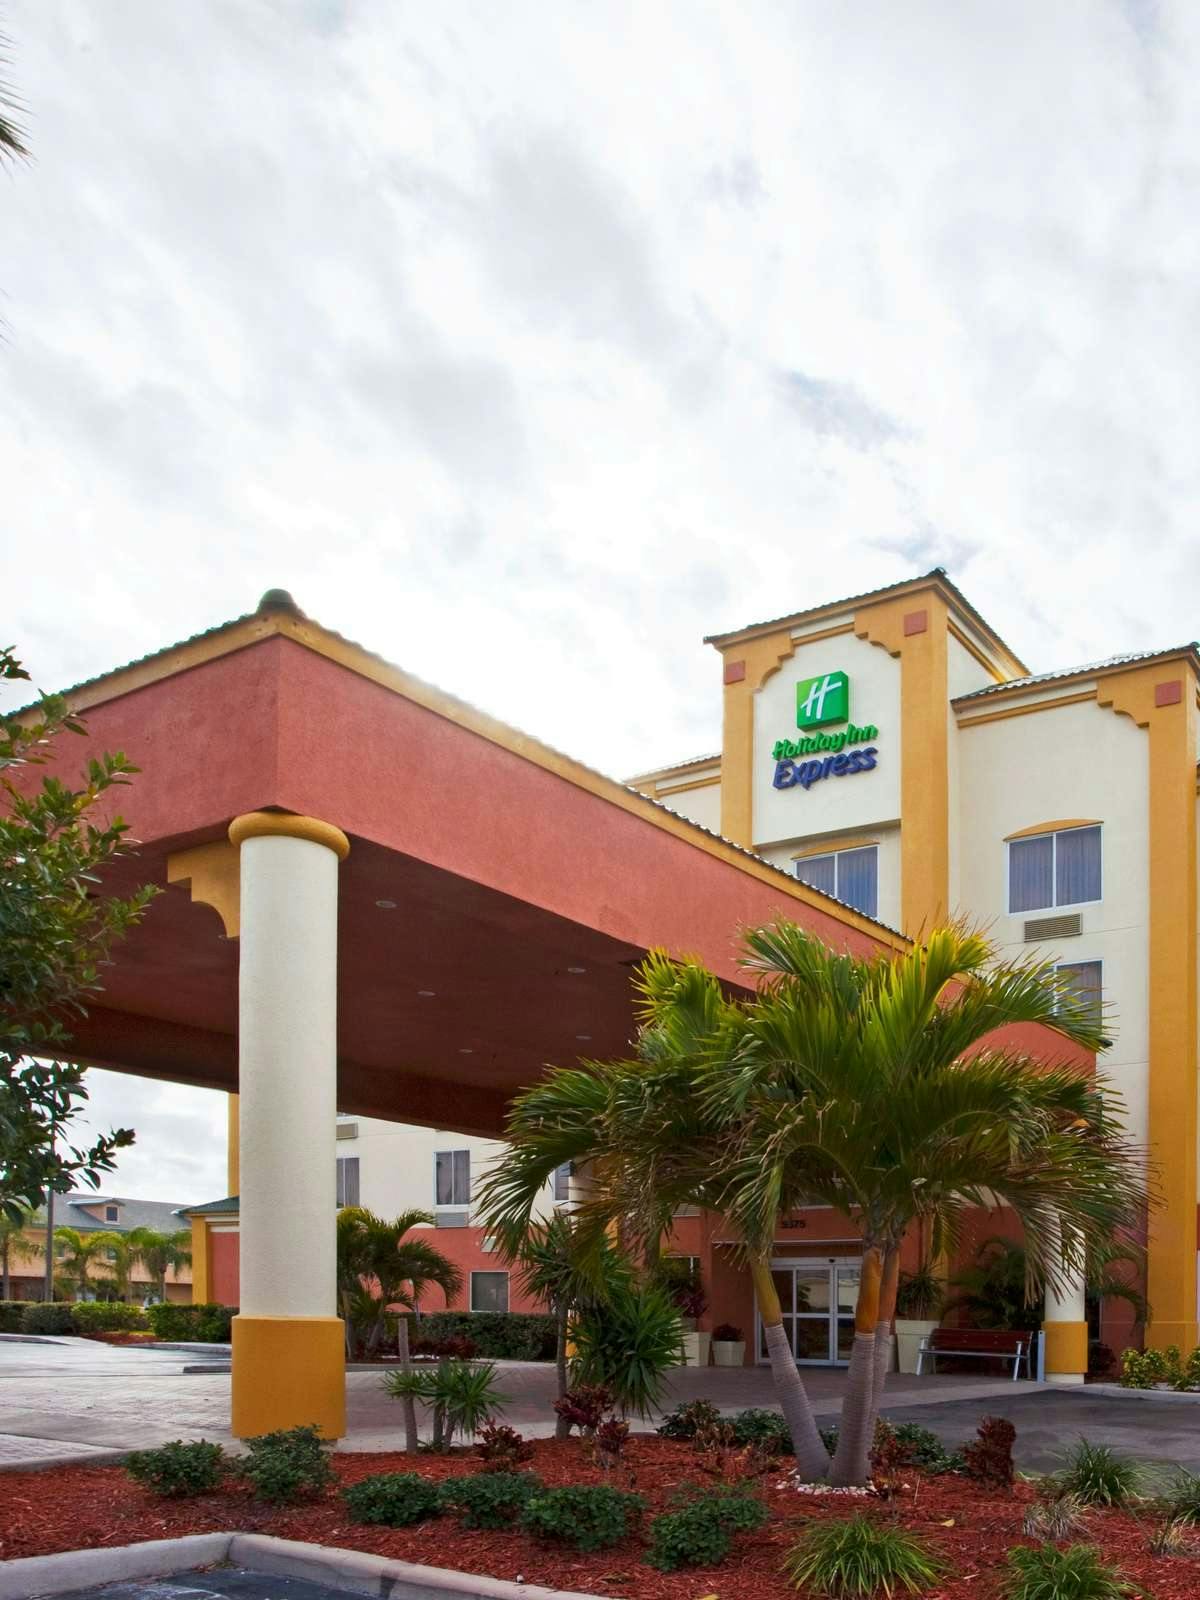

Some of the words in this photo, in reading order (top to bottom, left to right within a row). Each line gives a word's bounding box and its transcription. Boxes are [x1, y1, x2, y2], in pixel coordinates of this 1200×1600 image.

[800, 676, 842, 719] H
[772, 731, 845, 761] Holiday
[844, 723, 879, 745] Inn
[773, 747, 878, 790] Express
